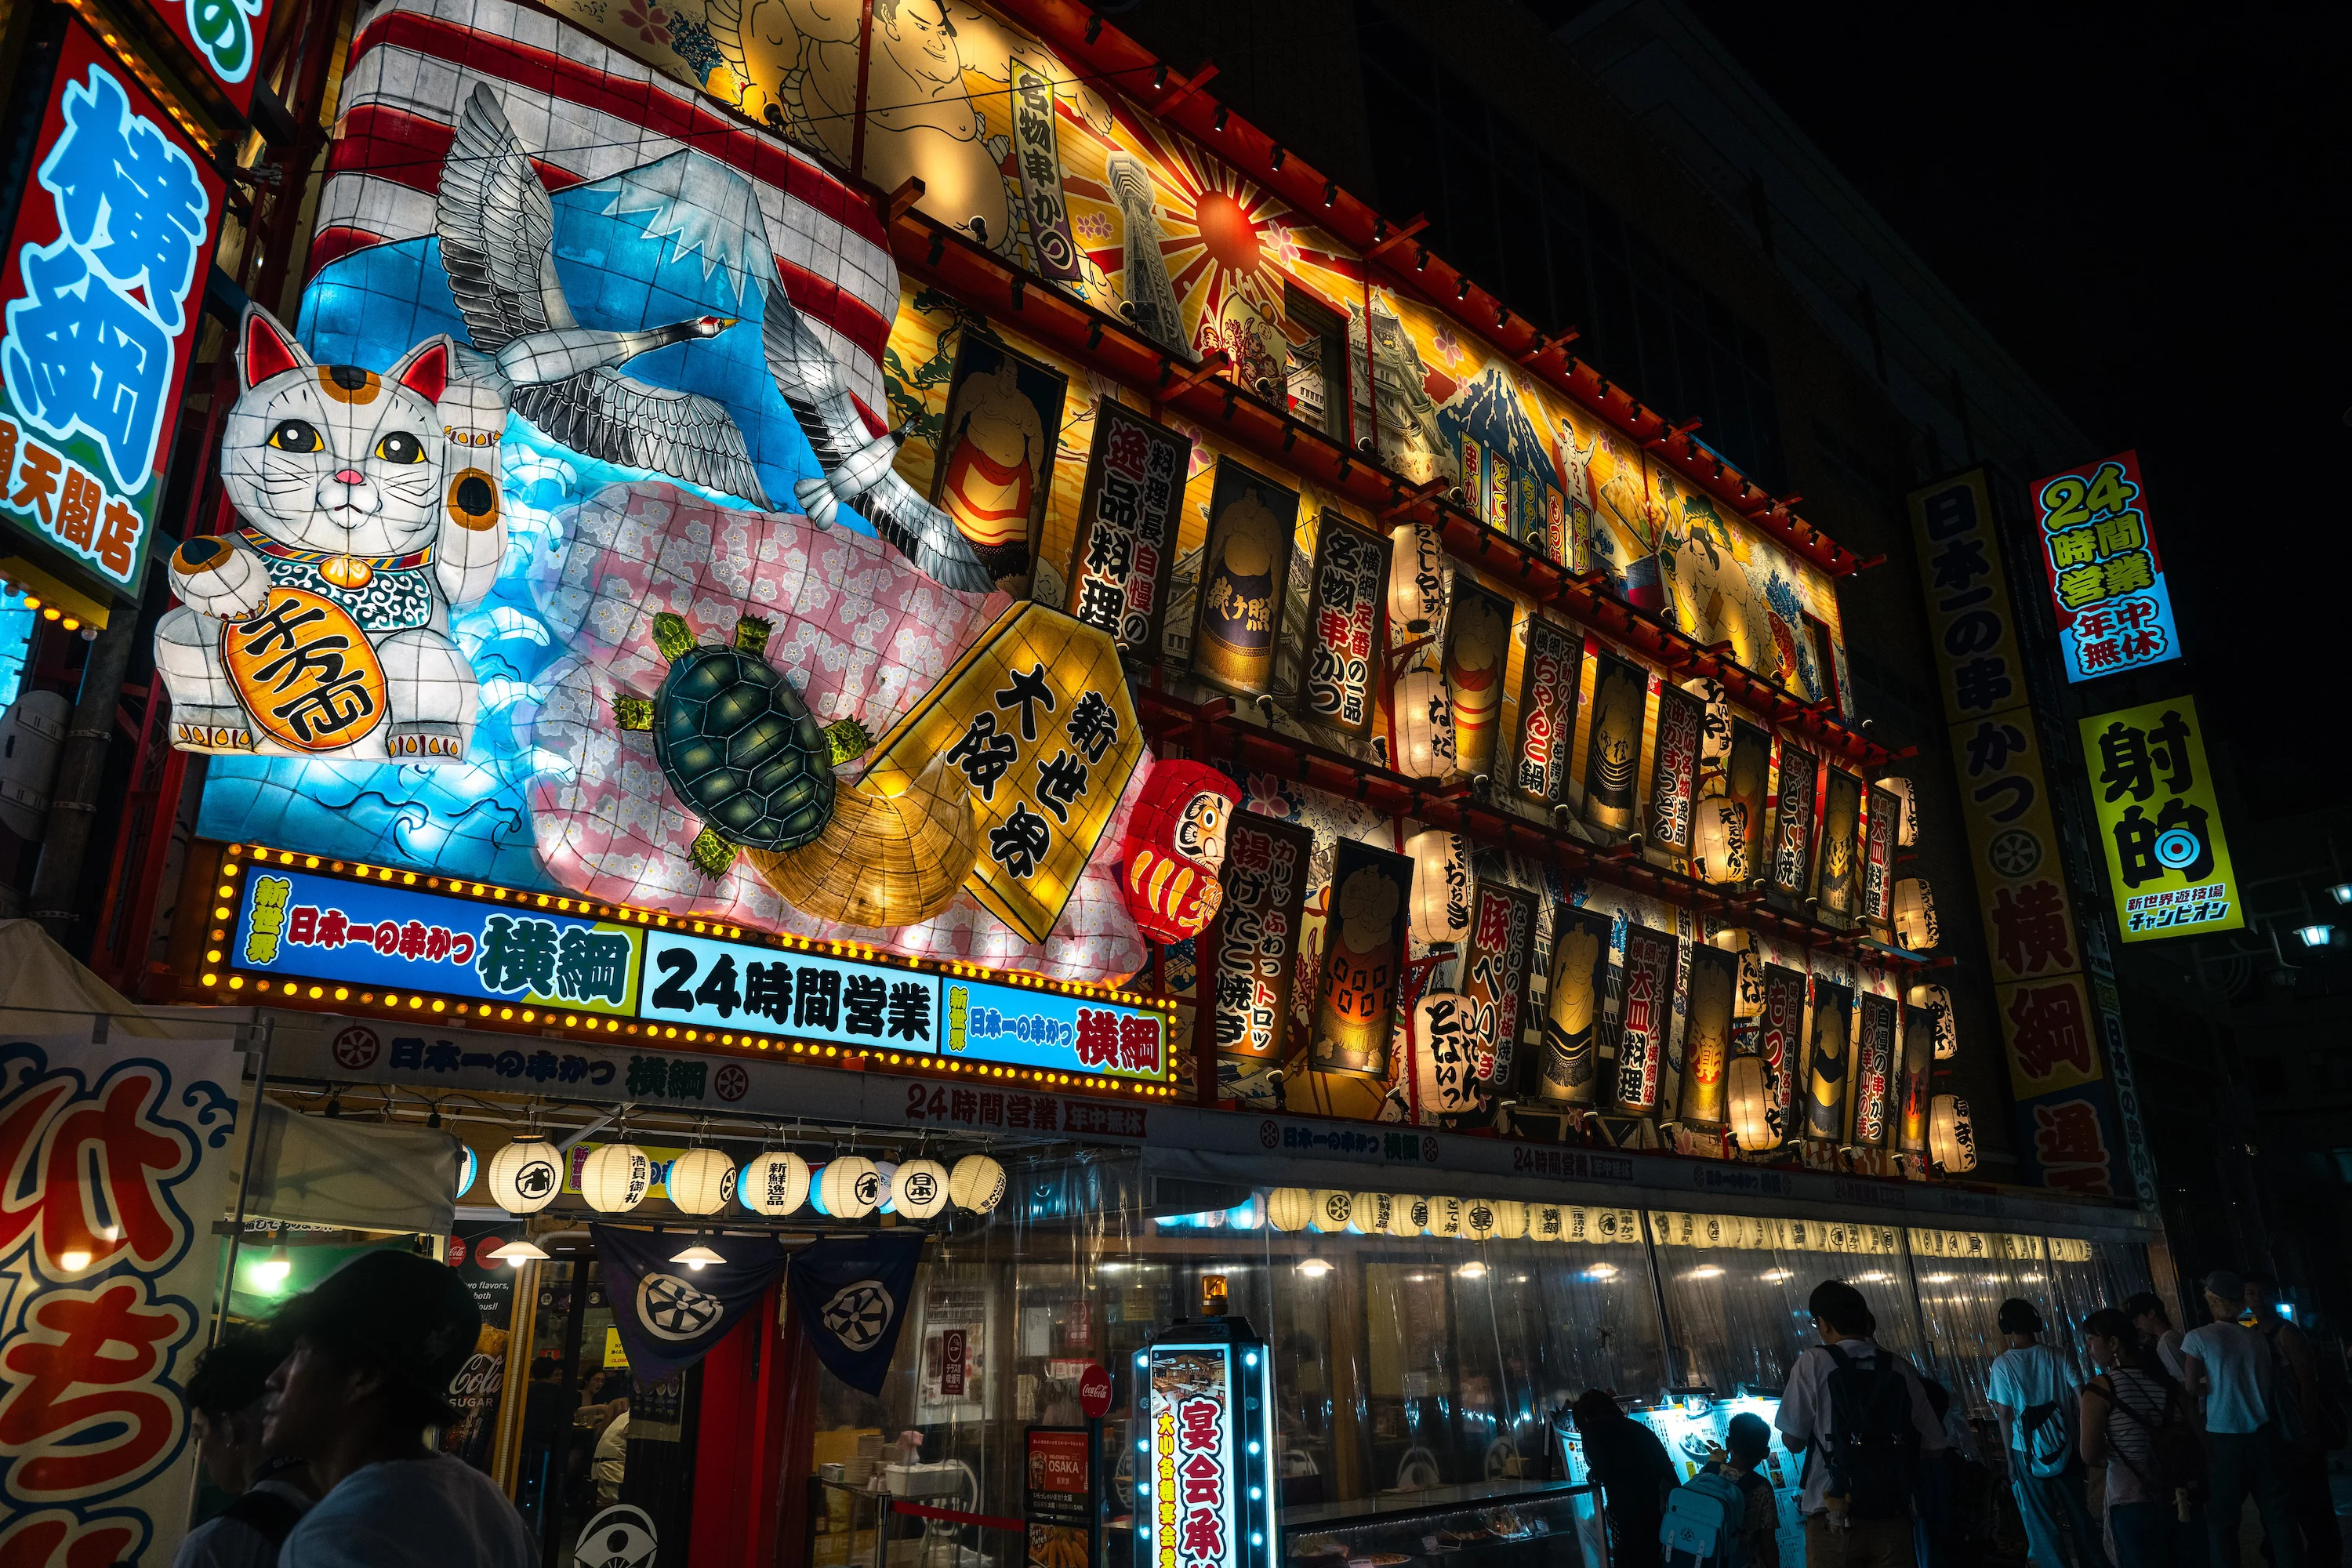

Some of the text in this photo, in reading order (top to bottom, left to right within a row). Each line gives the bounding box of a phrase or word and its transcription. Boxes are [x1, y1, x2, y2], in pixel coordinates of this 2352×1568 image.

[1019, 72, 1073, 270] 名物串かつ
[0, 63, 209, 495] 横綱
[2042, 465, 2136, 533] 24
[2050, 514, 2142, 568] 時間
[2060, 553, 2154, 608] 営業
[1309, 528, 1362, 714] 名物串かつ
[1342, 543, 1382, 726] 横綱定番の一品
[1923, 484, 2036, 825] 日本一の串かつ
[2077, 602, 2153, 640] 年中
[2082, 630, 2161, 670] 無休
[238, 598, 374, 742] 千万両
[2098, 710, 2216, 890] 射的
[245, 875, 291, 966] 新世界
[2127, 884, 2225, 913] 新世界遊技場
[2128, 902, 2230, 932] チャンピオン
[286, 905, 632, 1005] 日本一の串かつ 横綱
[652, 948, 931, 1043] 24時間営業
[948, 986, 971, 1054] 新世界
[389, 1036, 709, 1102] 日本一の串かつ 横綱
[969, 1006, 1163, 1076] 日本一の串かつ 横綱
[906, 1082, 1059, 1131] 24時間営業
[766, 1162, 788, 1206] 新鮮逸品
[474, 1292, 492, 1301] both
[477, 1281, 510, 1290] flavors,
[448, 1397, 494, 1407] SUGAR
[1048, 1461, 1080, 1474] OSAKA
[1182, 1400, 1221, 1568] 宴会承
